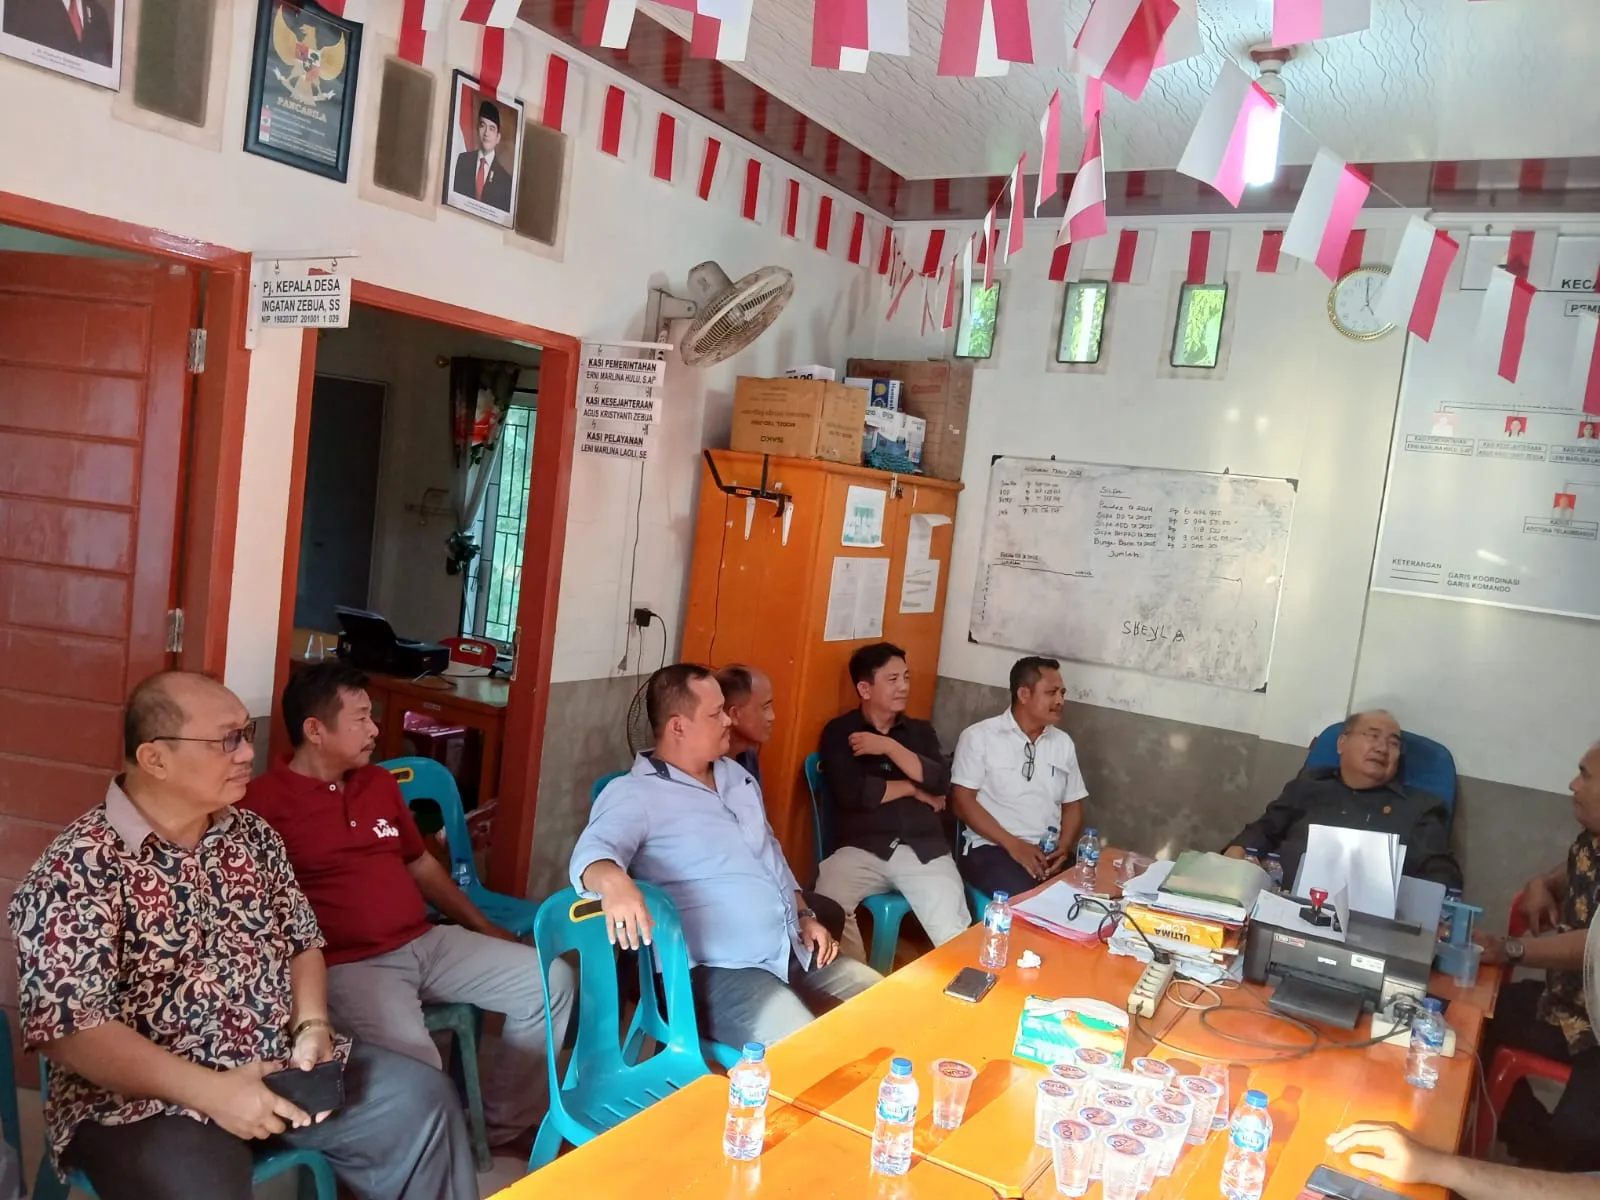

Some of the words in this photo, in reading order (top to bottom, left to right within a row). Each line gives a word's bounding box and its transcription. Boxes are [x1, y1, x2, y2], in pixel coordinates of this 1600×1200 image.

[263, 281, 274, 296] Pj.
[276, 280, 312, 292] KEPALA
[314, 279, 340, 291] DESA
[262, 300, 295, 312] INGATAN
[297, 300, 326, 312] ZEBUA,
[329, 299, 340, 310] SS
[588, 358, 603, 368] KASI
[605, 360, 656, 372] PEMERINTAHAN
[586, 371, 599, 380] ERNI
[600, 372, 624, 381] MARLINA
[586, 396, 600, 406] KASI
[601, 398, 654, 409] KESEJAHTERAAN
[584, 409, 599, 418] AGUS
[600, 410, 632, 421] KRISTYANTI
[633, 412, 653, 422] ZEBUA
[587, 432, 602, 440] KASI
[604, 433, 644, 446] PELAYANAN
[581, 444, 594, 452] LENI
[594, 446, 621, 456] MARLINA
[639, 451, 648, 459] SE
[1392, 558, 1442, 569] KETERANGAN
[1448, 572, 1471, 580] GARIS
[1473, 574, 1520, 586] KOORDINASI
[1447, 580, 1470, 589] GARIS
[1472, 583, 1511, 593] KOMANDO
[1154, 928, 1191, 942] ULTIMA
